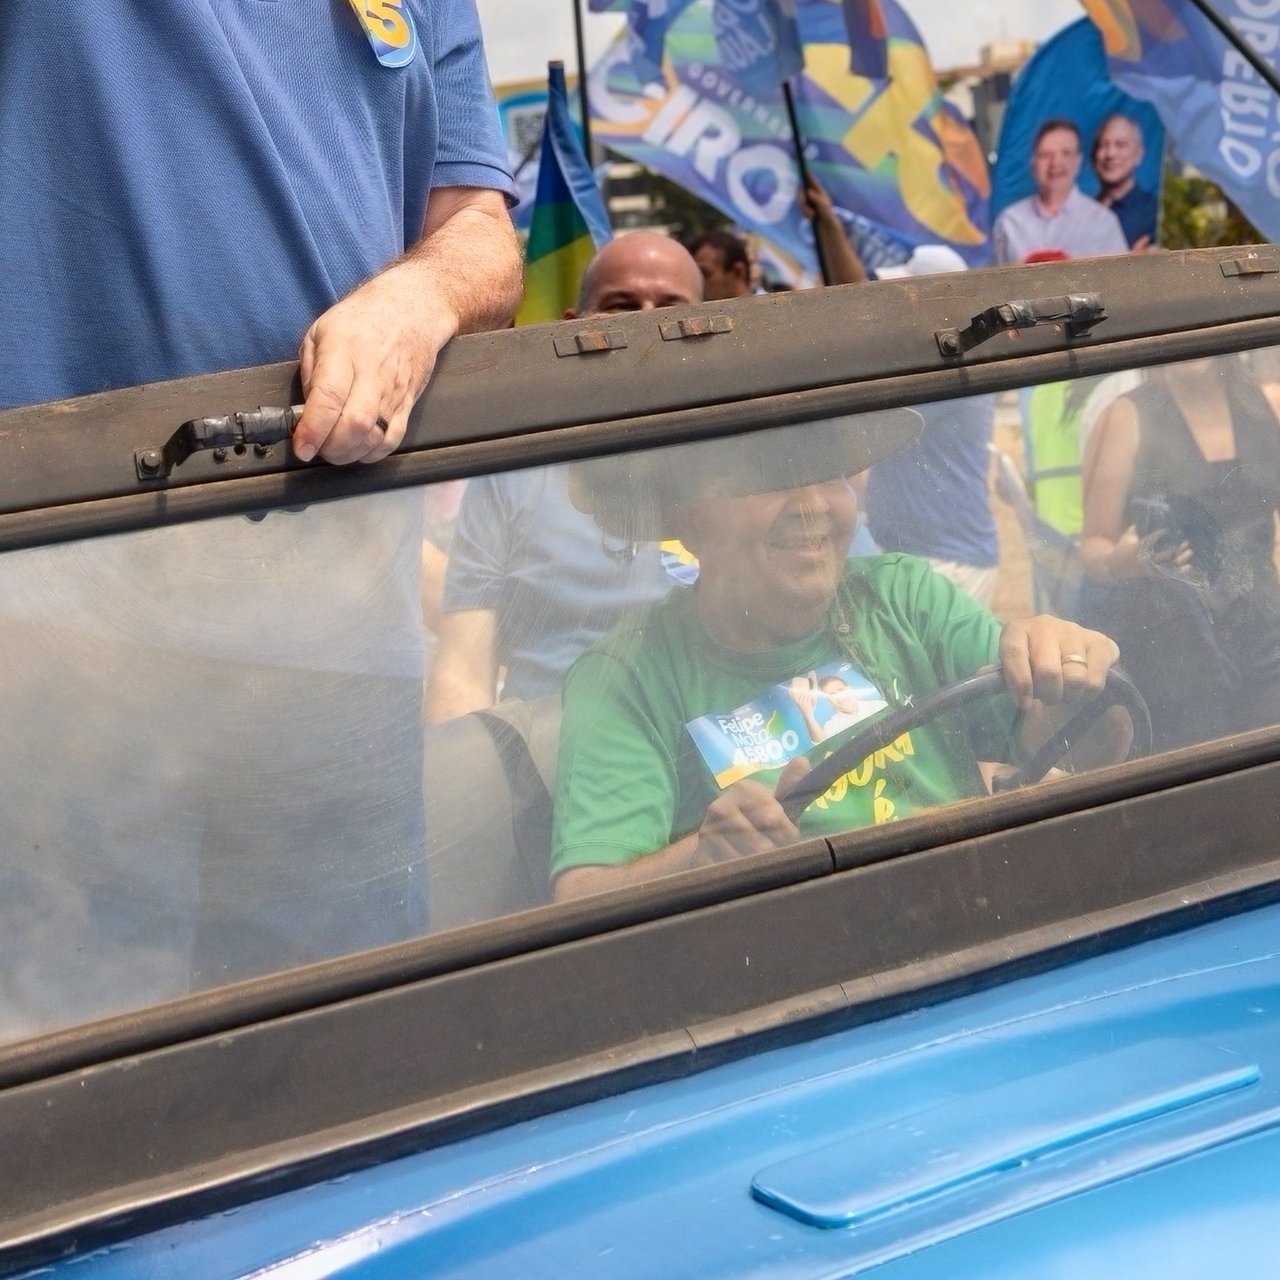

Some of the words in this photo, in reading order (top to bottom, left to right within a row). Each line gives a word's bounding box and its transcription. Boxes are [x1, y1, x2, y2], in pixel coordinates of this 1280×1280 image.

[587, 50, 799, 225] CIRO
[718, 712, 765, 735] Felipe
[730, 728, 770, 748] Mota
[733, 729, 799, 768] 45800
